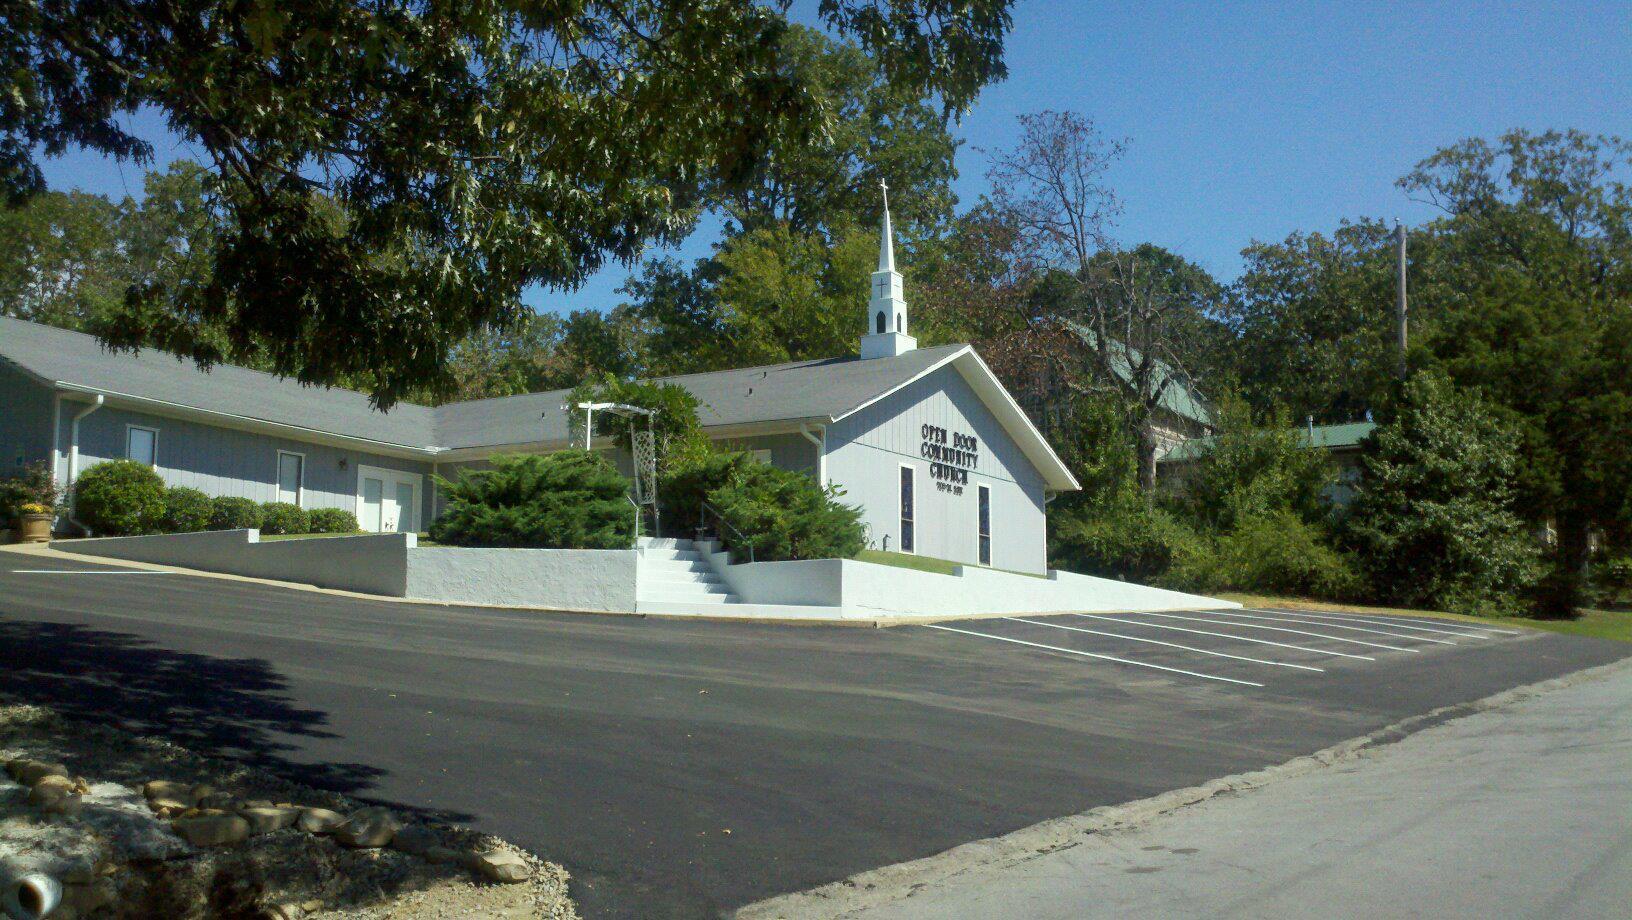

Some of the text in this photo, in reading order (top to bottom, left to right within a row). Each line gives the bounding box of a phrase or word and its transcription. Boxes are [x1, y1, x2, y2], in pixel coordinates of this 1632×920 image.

[921, 424, 977, 452] OPEN DOOR
[921, 442, 979, 470] COMMUNITY
[929, 462, 968, 486] CHURCH
